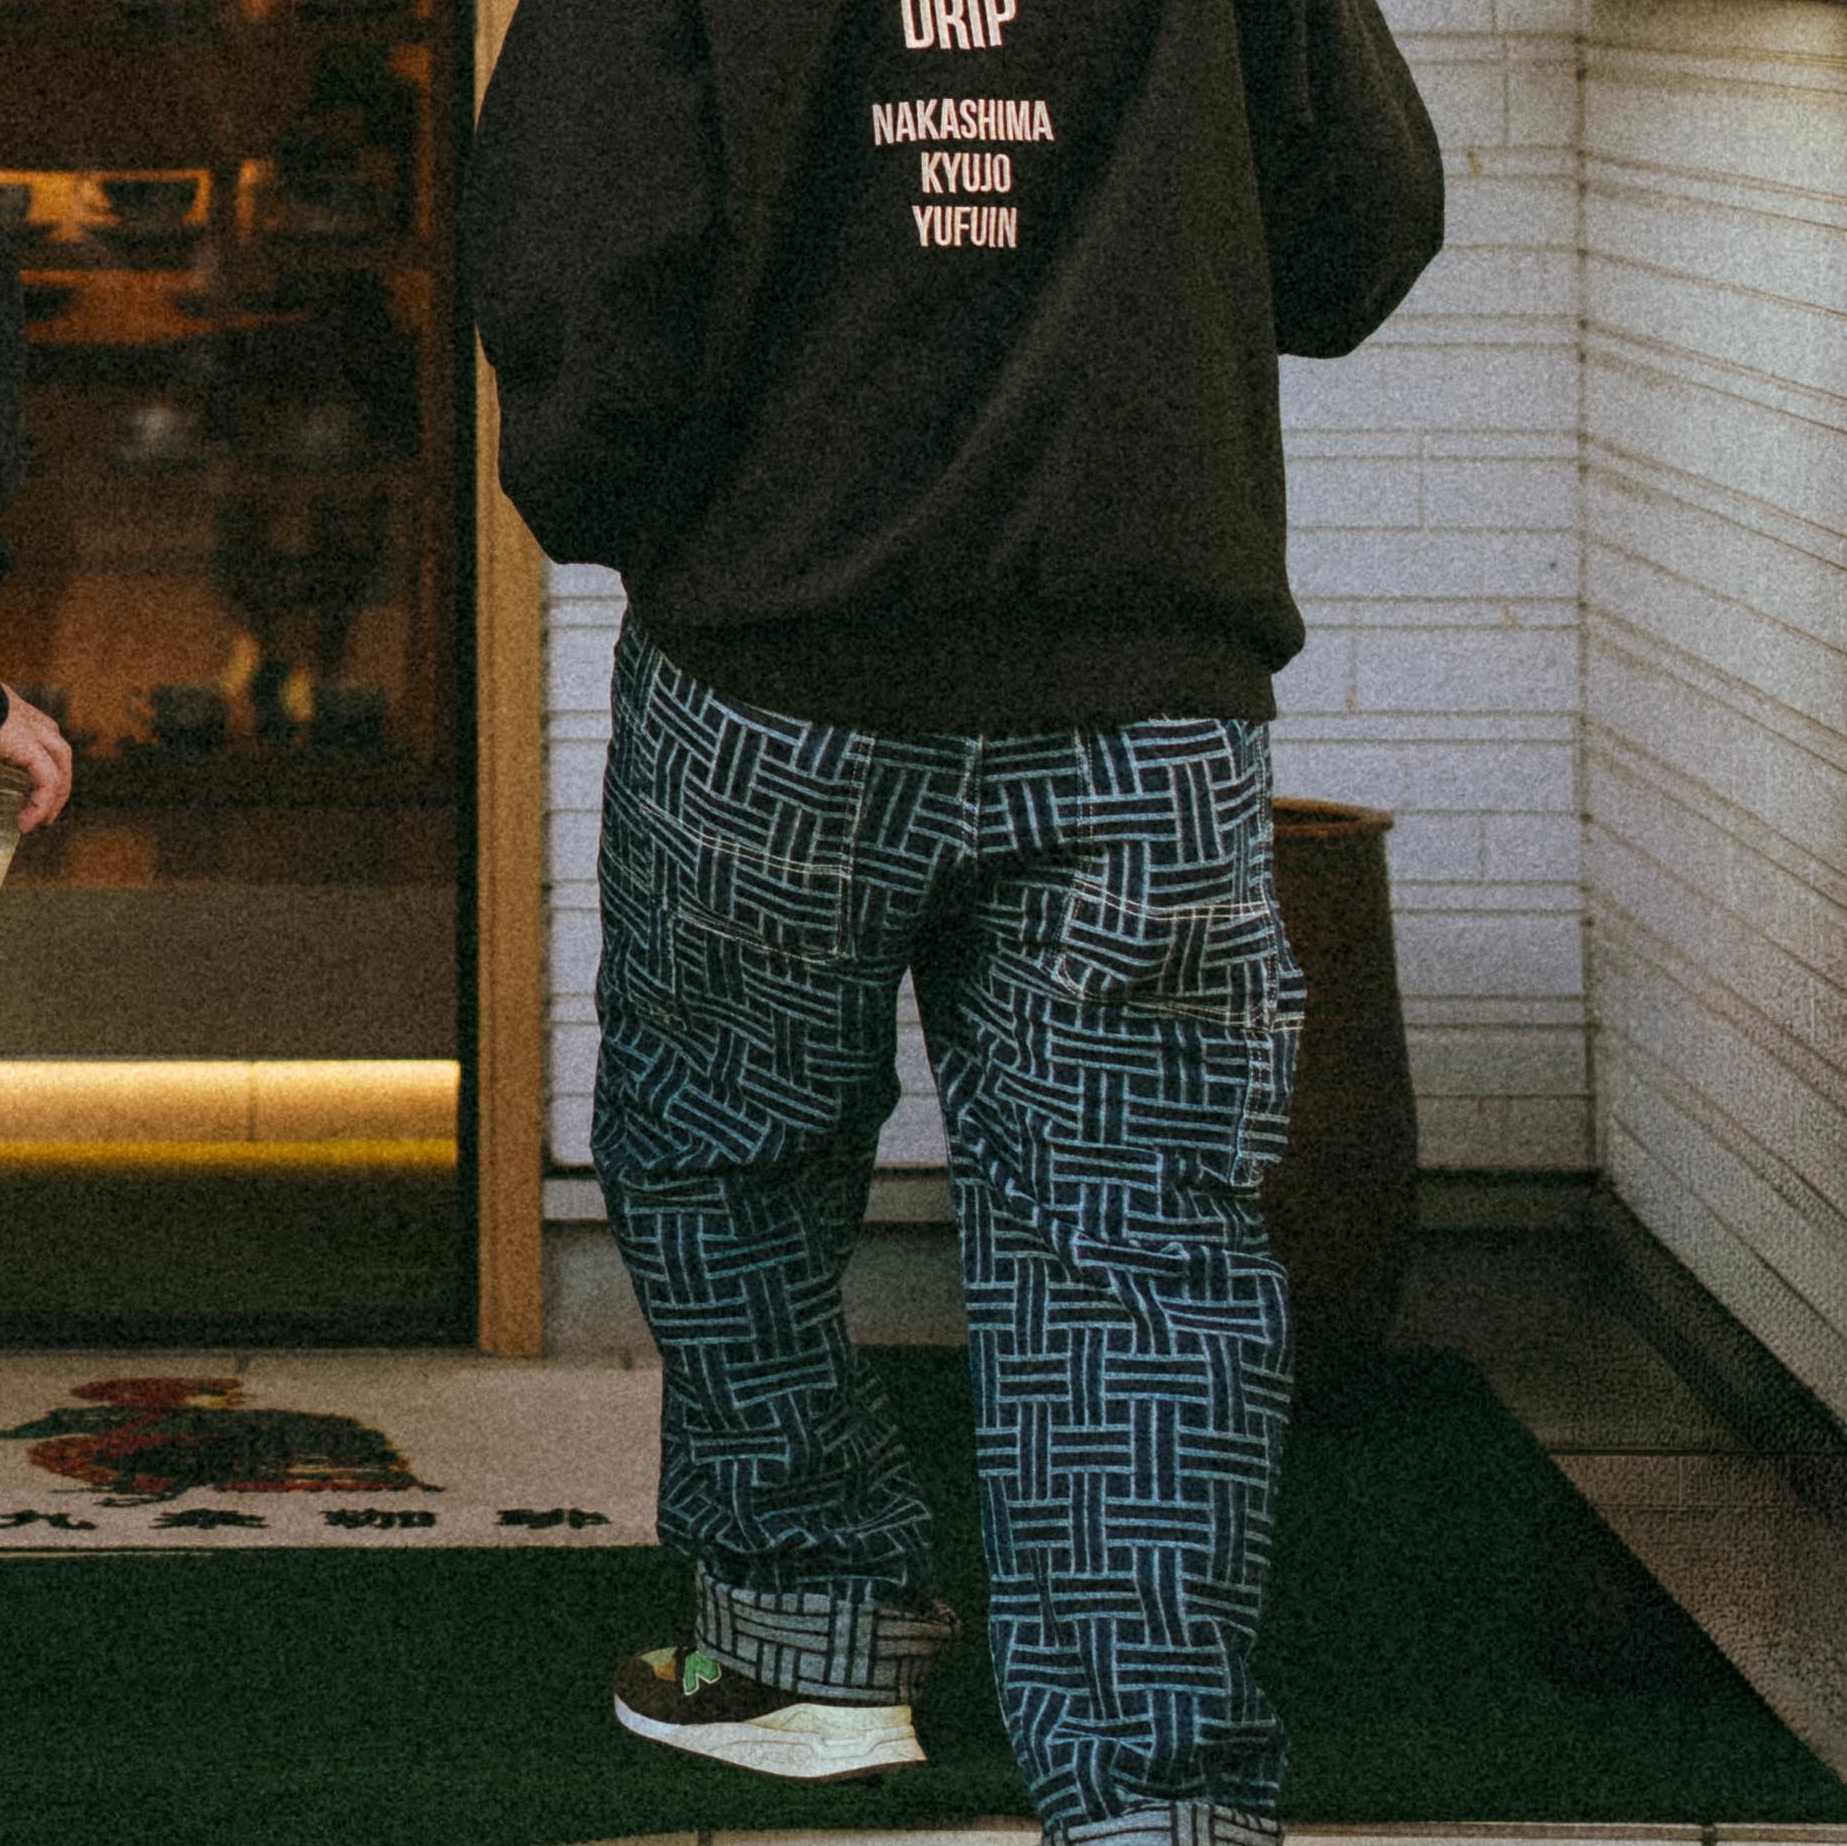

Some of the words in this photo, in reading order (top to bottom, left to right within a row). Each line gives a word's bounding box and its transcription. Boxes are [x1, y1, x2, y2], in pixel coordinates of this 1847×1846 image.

[871, 98, 1056, 147] NAKASHIMA
[920, 151, 1012, 194] KYUJO
[911, 205, 1018, 249] YUFUIN
